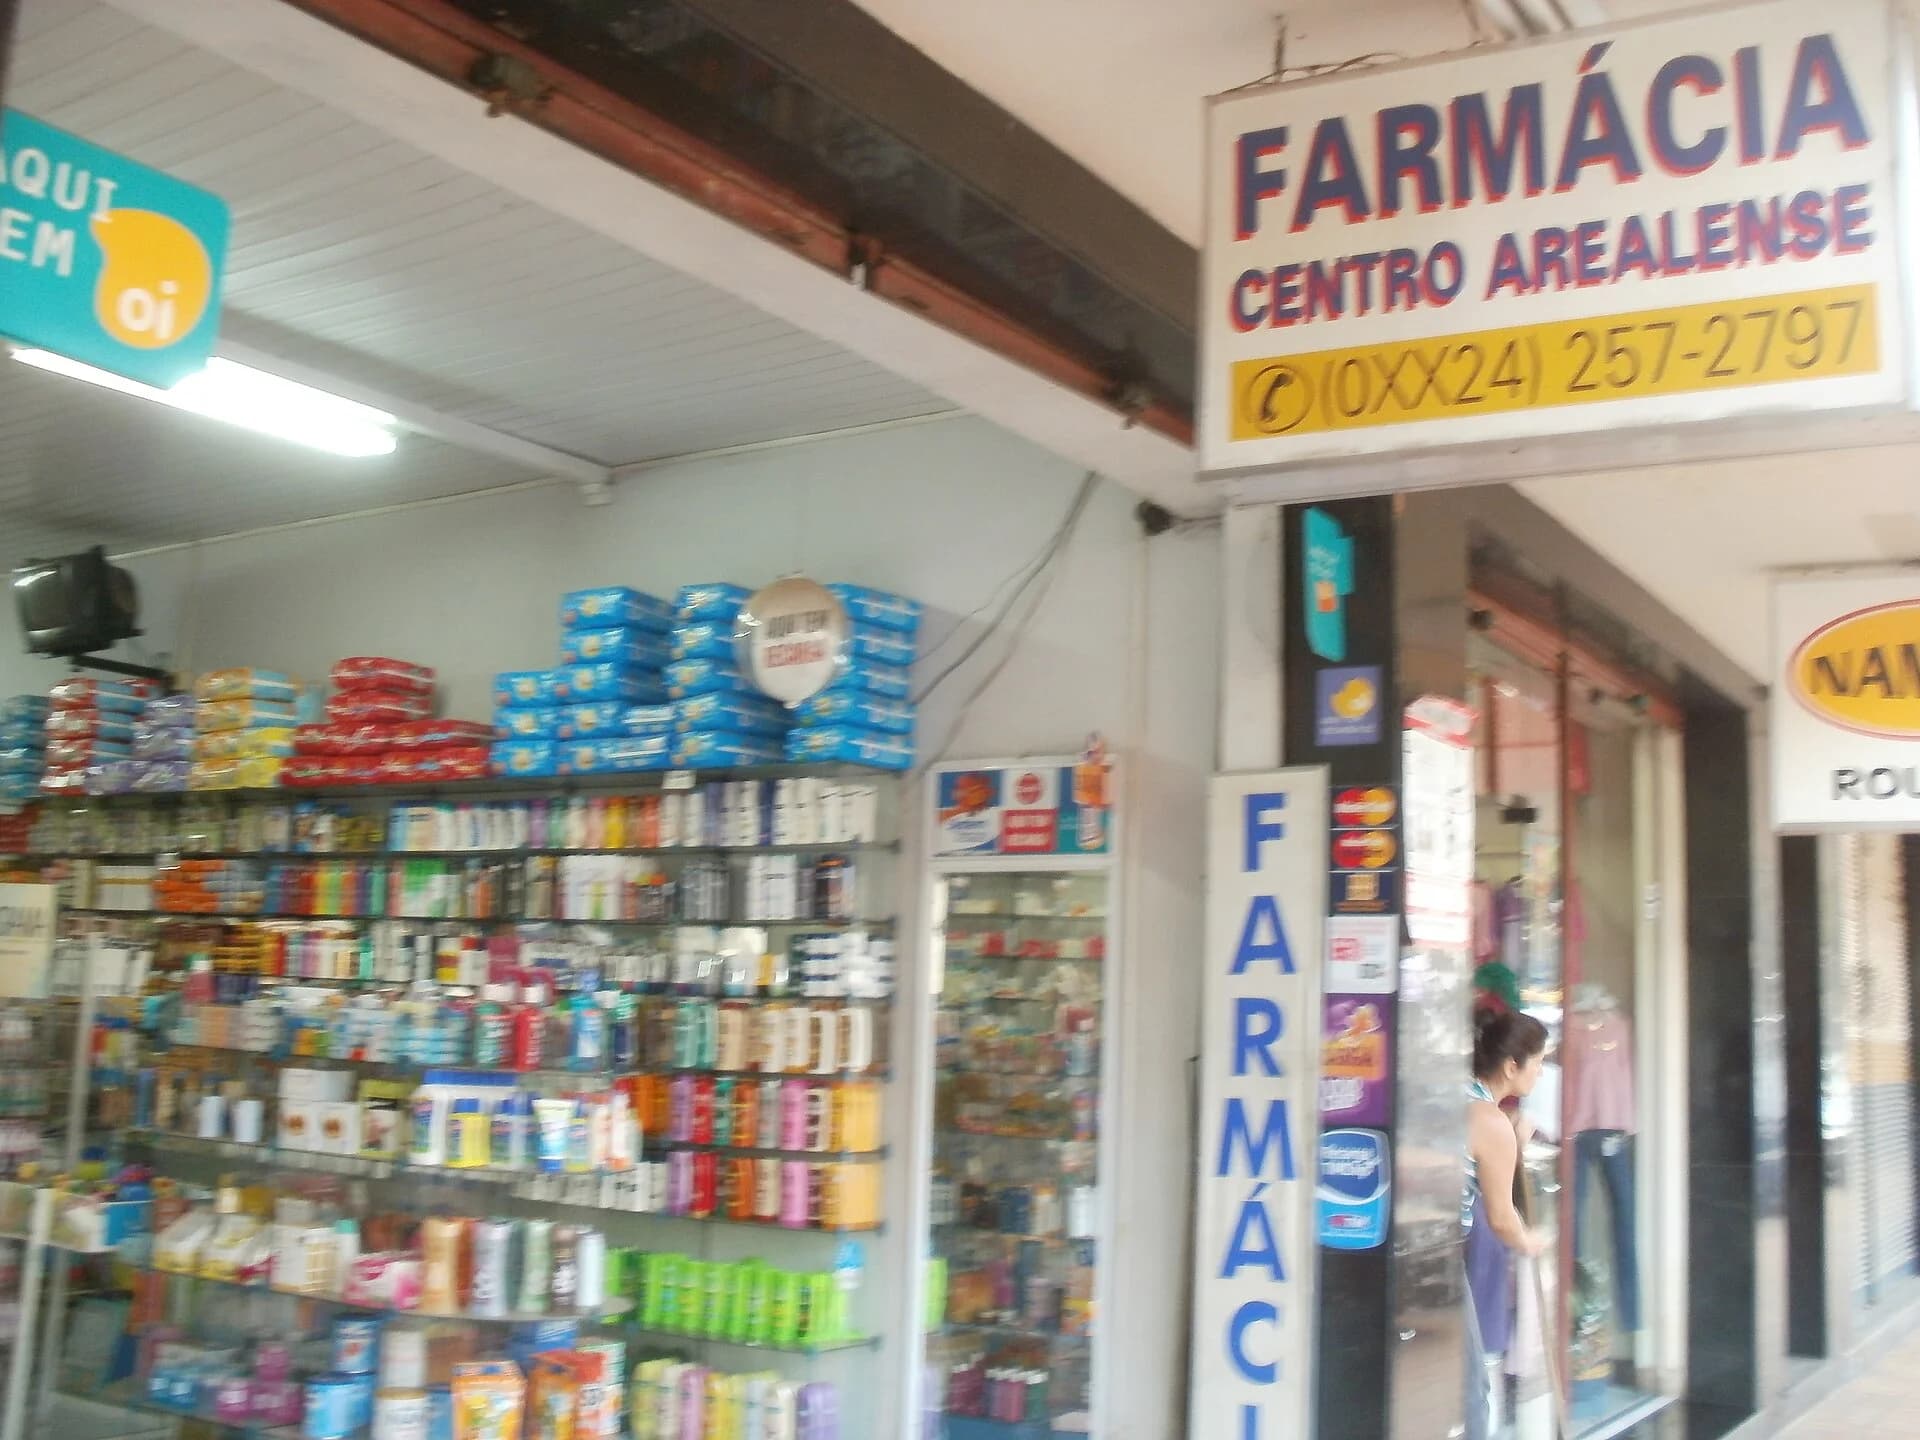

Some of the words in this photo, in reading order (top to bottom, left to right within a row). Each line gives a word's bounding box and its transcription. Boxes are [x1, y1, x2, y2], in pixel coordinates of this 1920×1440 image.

[0, 148, 118, 224] QUI
[1233, 33, 1872, 242] FARMÁCIA
[1228, 241, 1464, 333] CENTRO
[1485, 183, 1874, 299] AREALENSE
[1566, 300, 1864, 392] 257-2797
